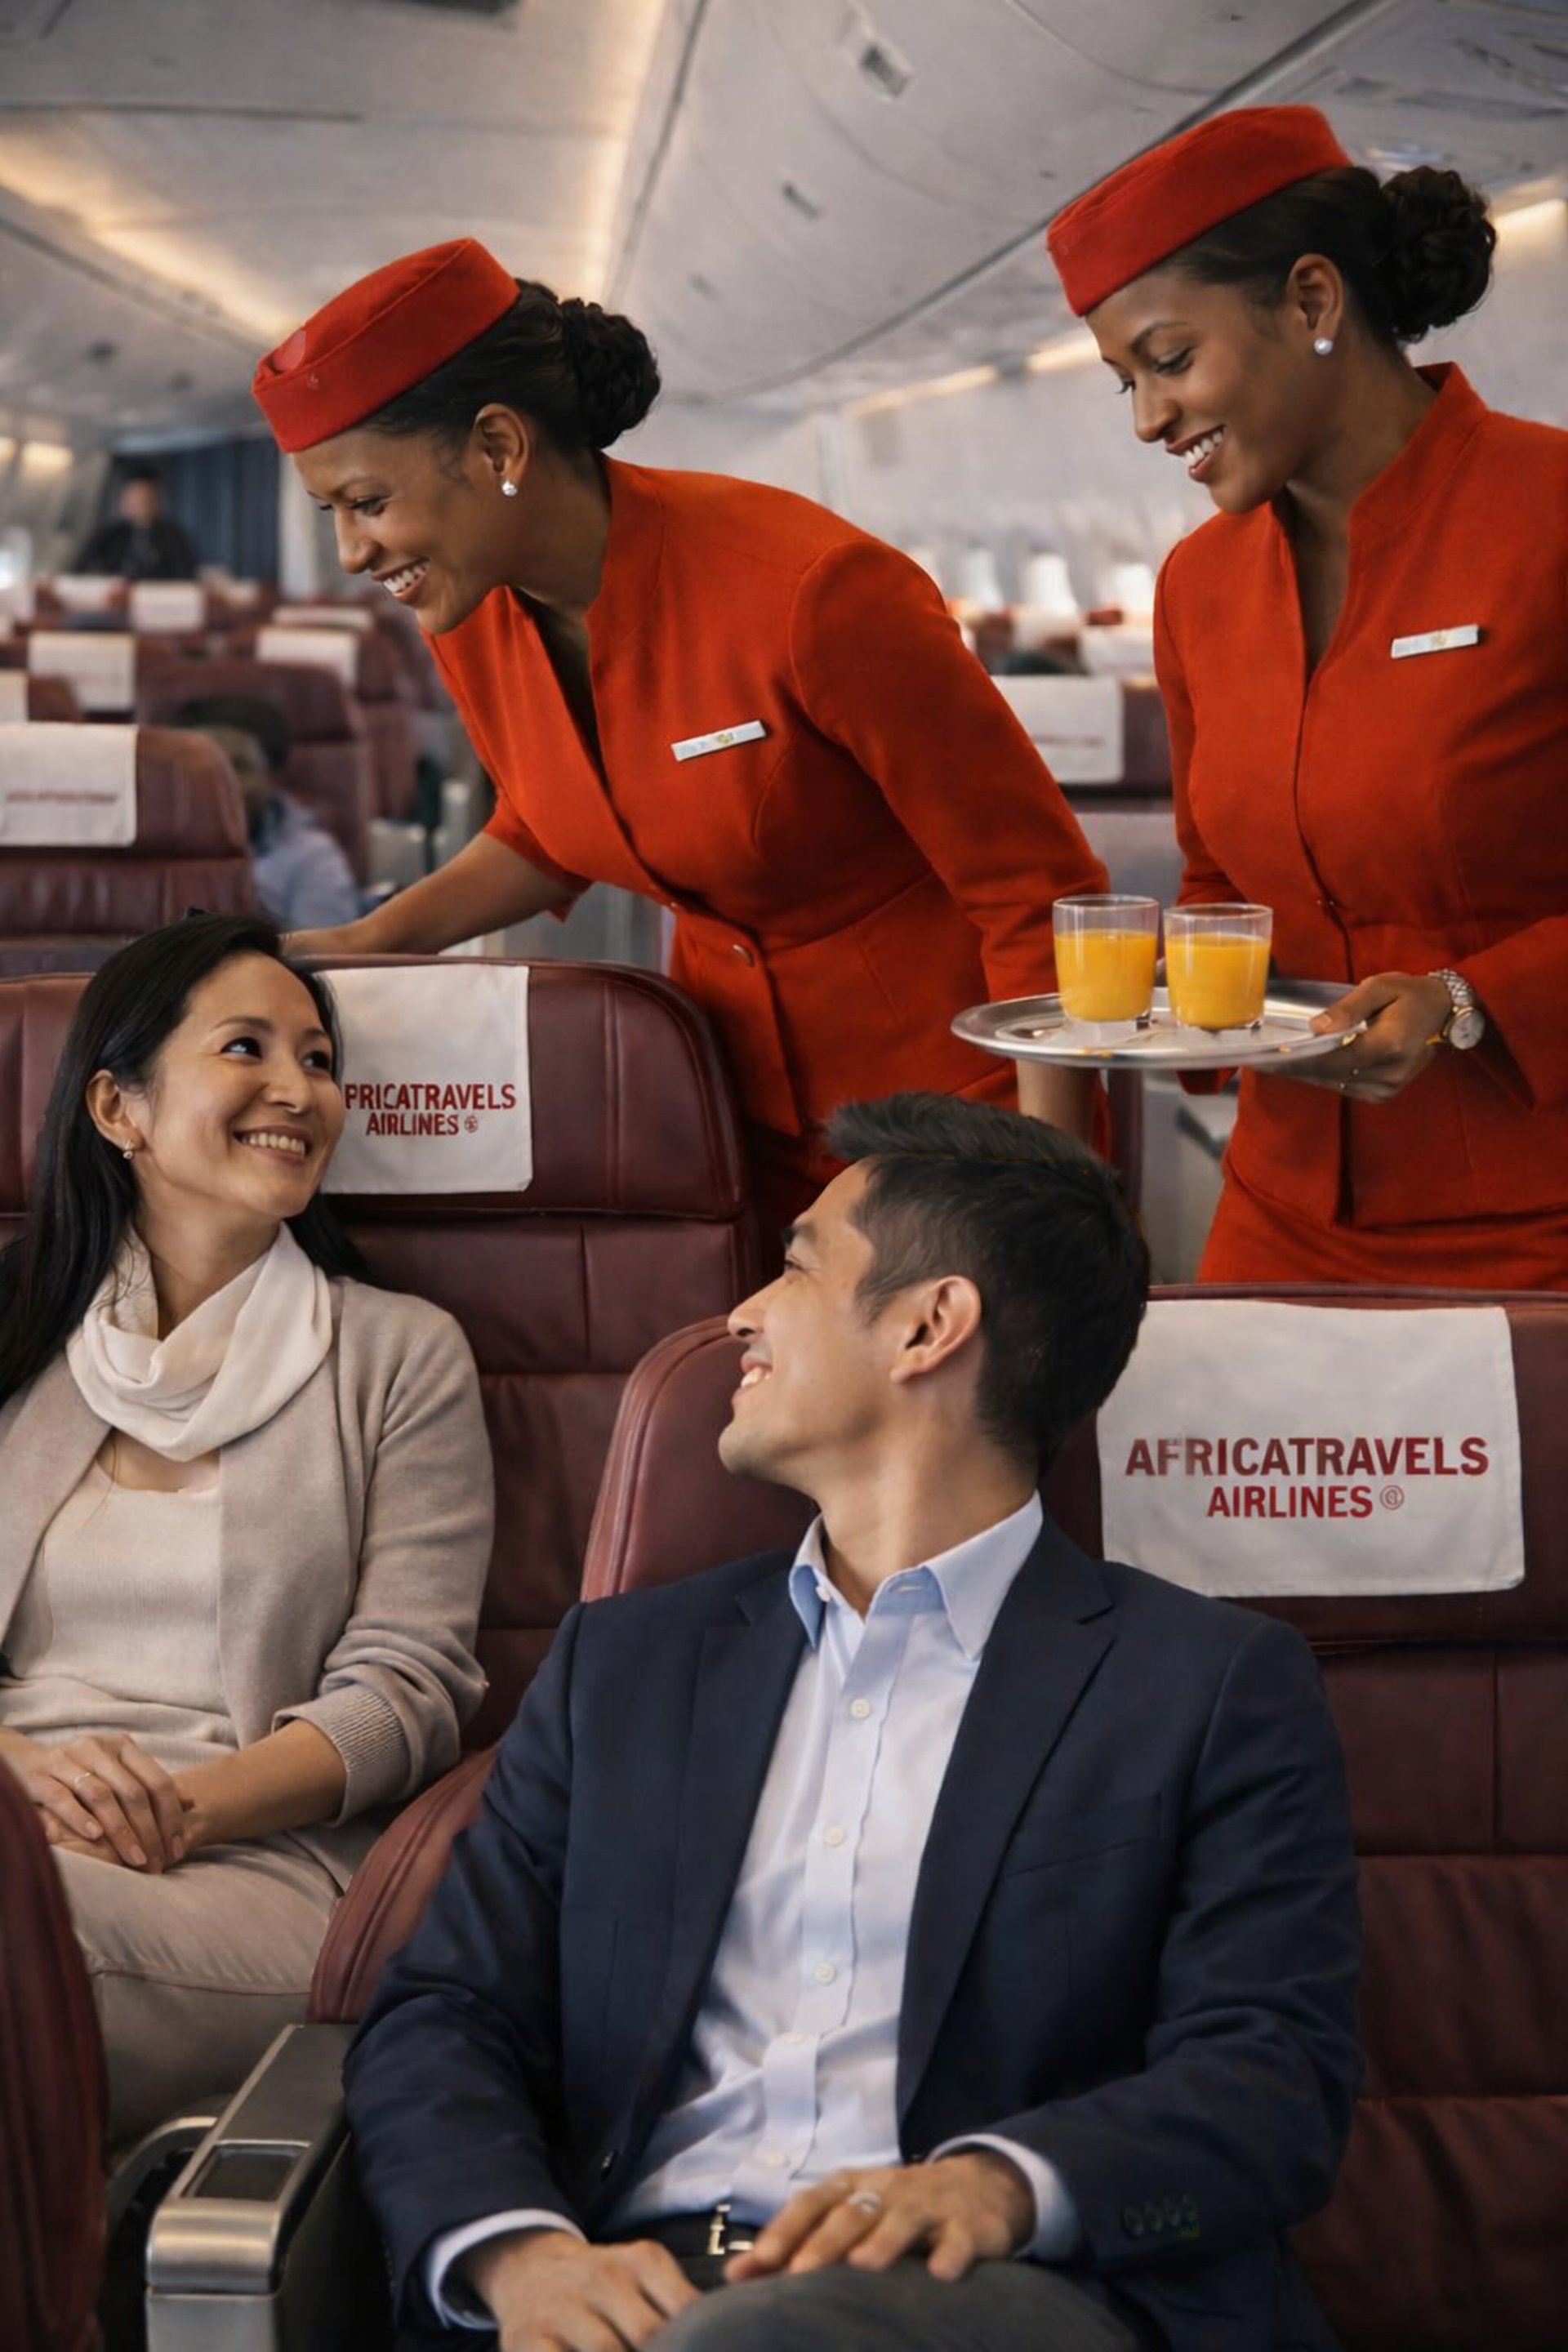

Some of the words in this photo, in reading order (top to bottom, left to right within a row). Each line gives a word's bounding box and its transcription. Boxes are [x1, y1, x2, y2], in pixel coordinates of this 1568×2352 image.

[366, 1112, 459, 1136] AIRLINES
[1125, 1437, 1490, 1476] AFRICATRAVELS
[1206, 1485, 1373, 1518] AIRLINES
